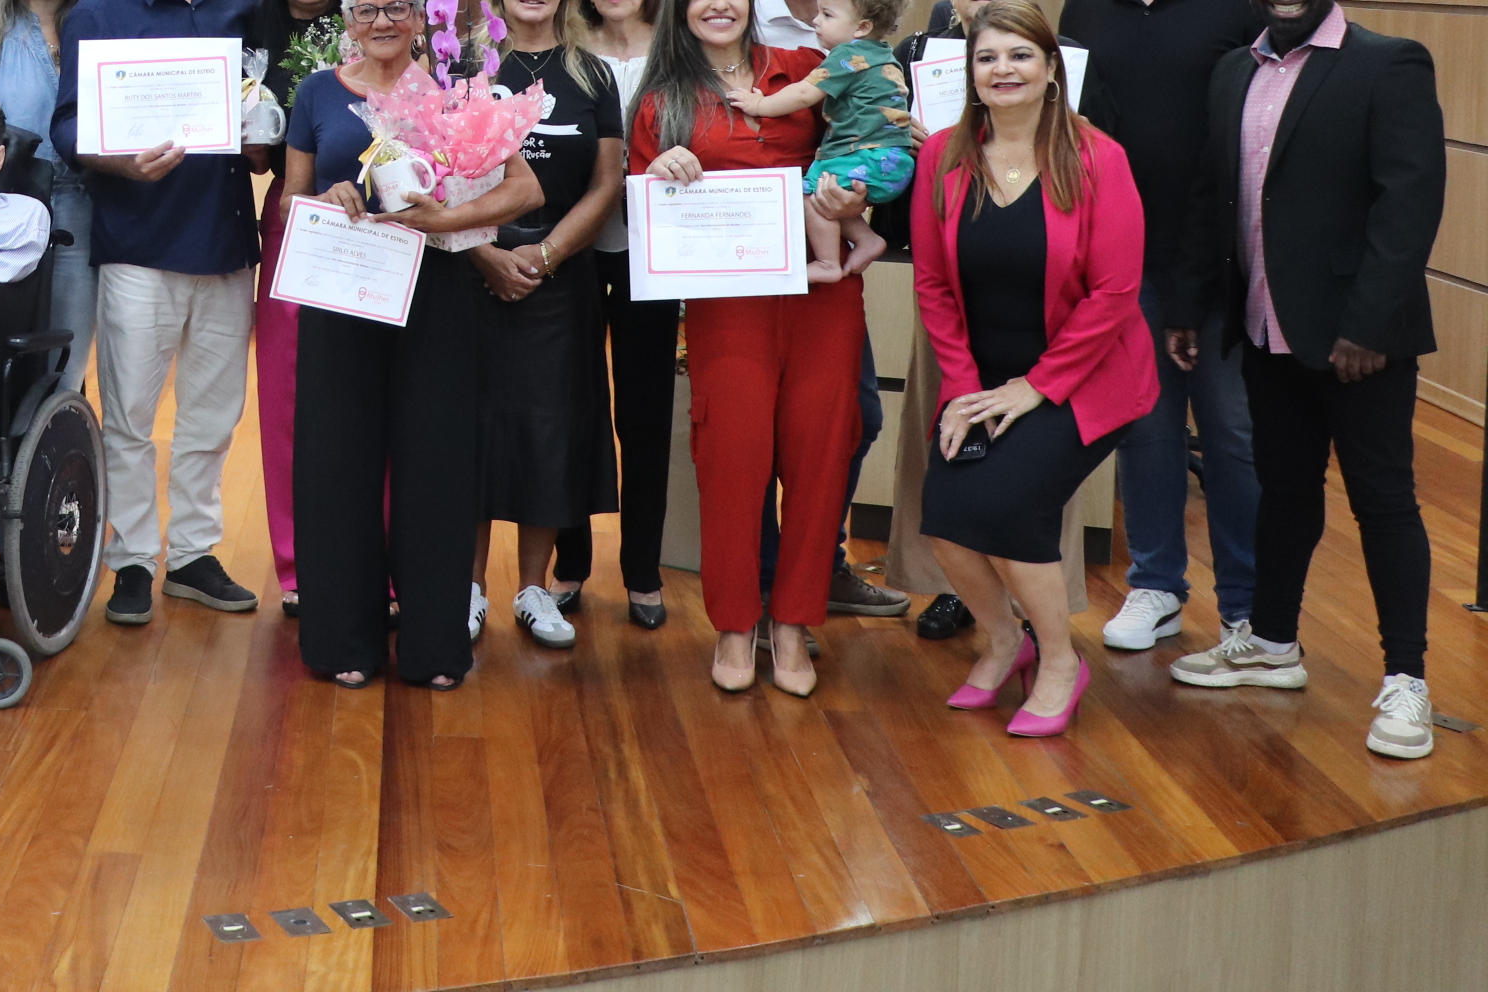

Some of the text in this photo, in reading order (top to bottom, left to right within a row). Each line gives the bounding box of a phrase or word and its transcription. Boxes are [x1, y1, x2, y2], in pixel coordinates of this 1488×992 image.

[321, 219, 409, 245] CÂMARA MUNICIPAL DE ESTEIO
[332, 245, 367, 259] SIRLEI ALVES
